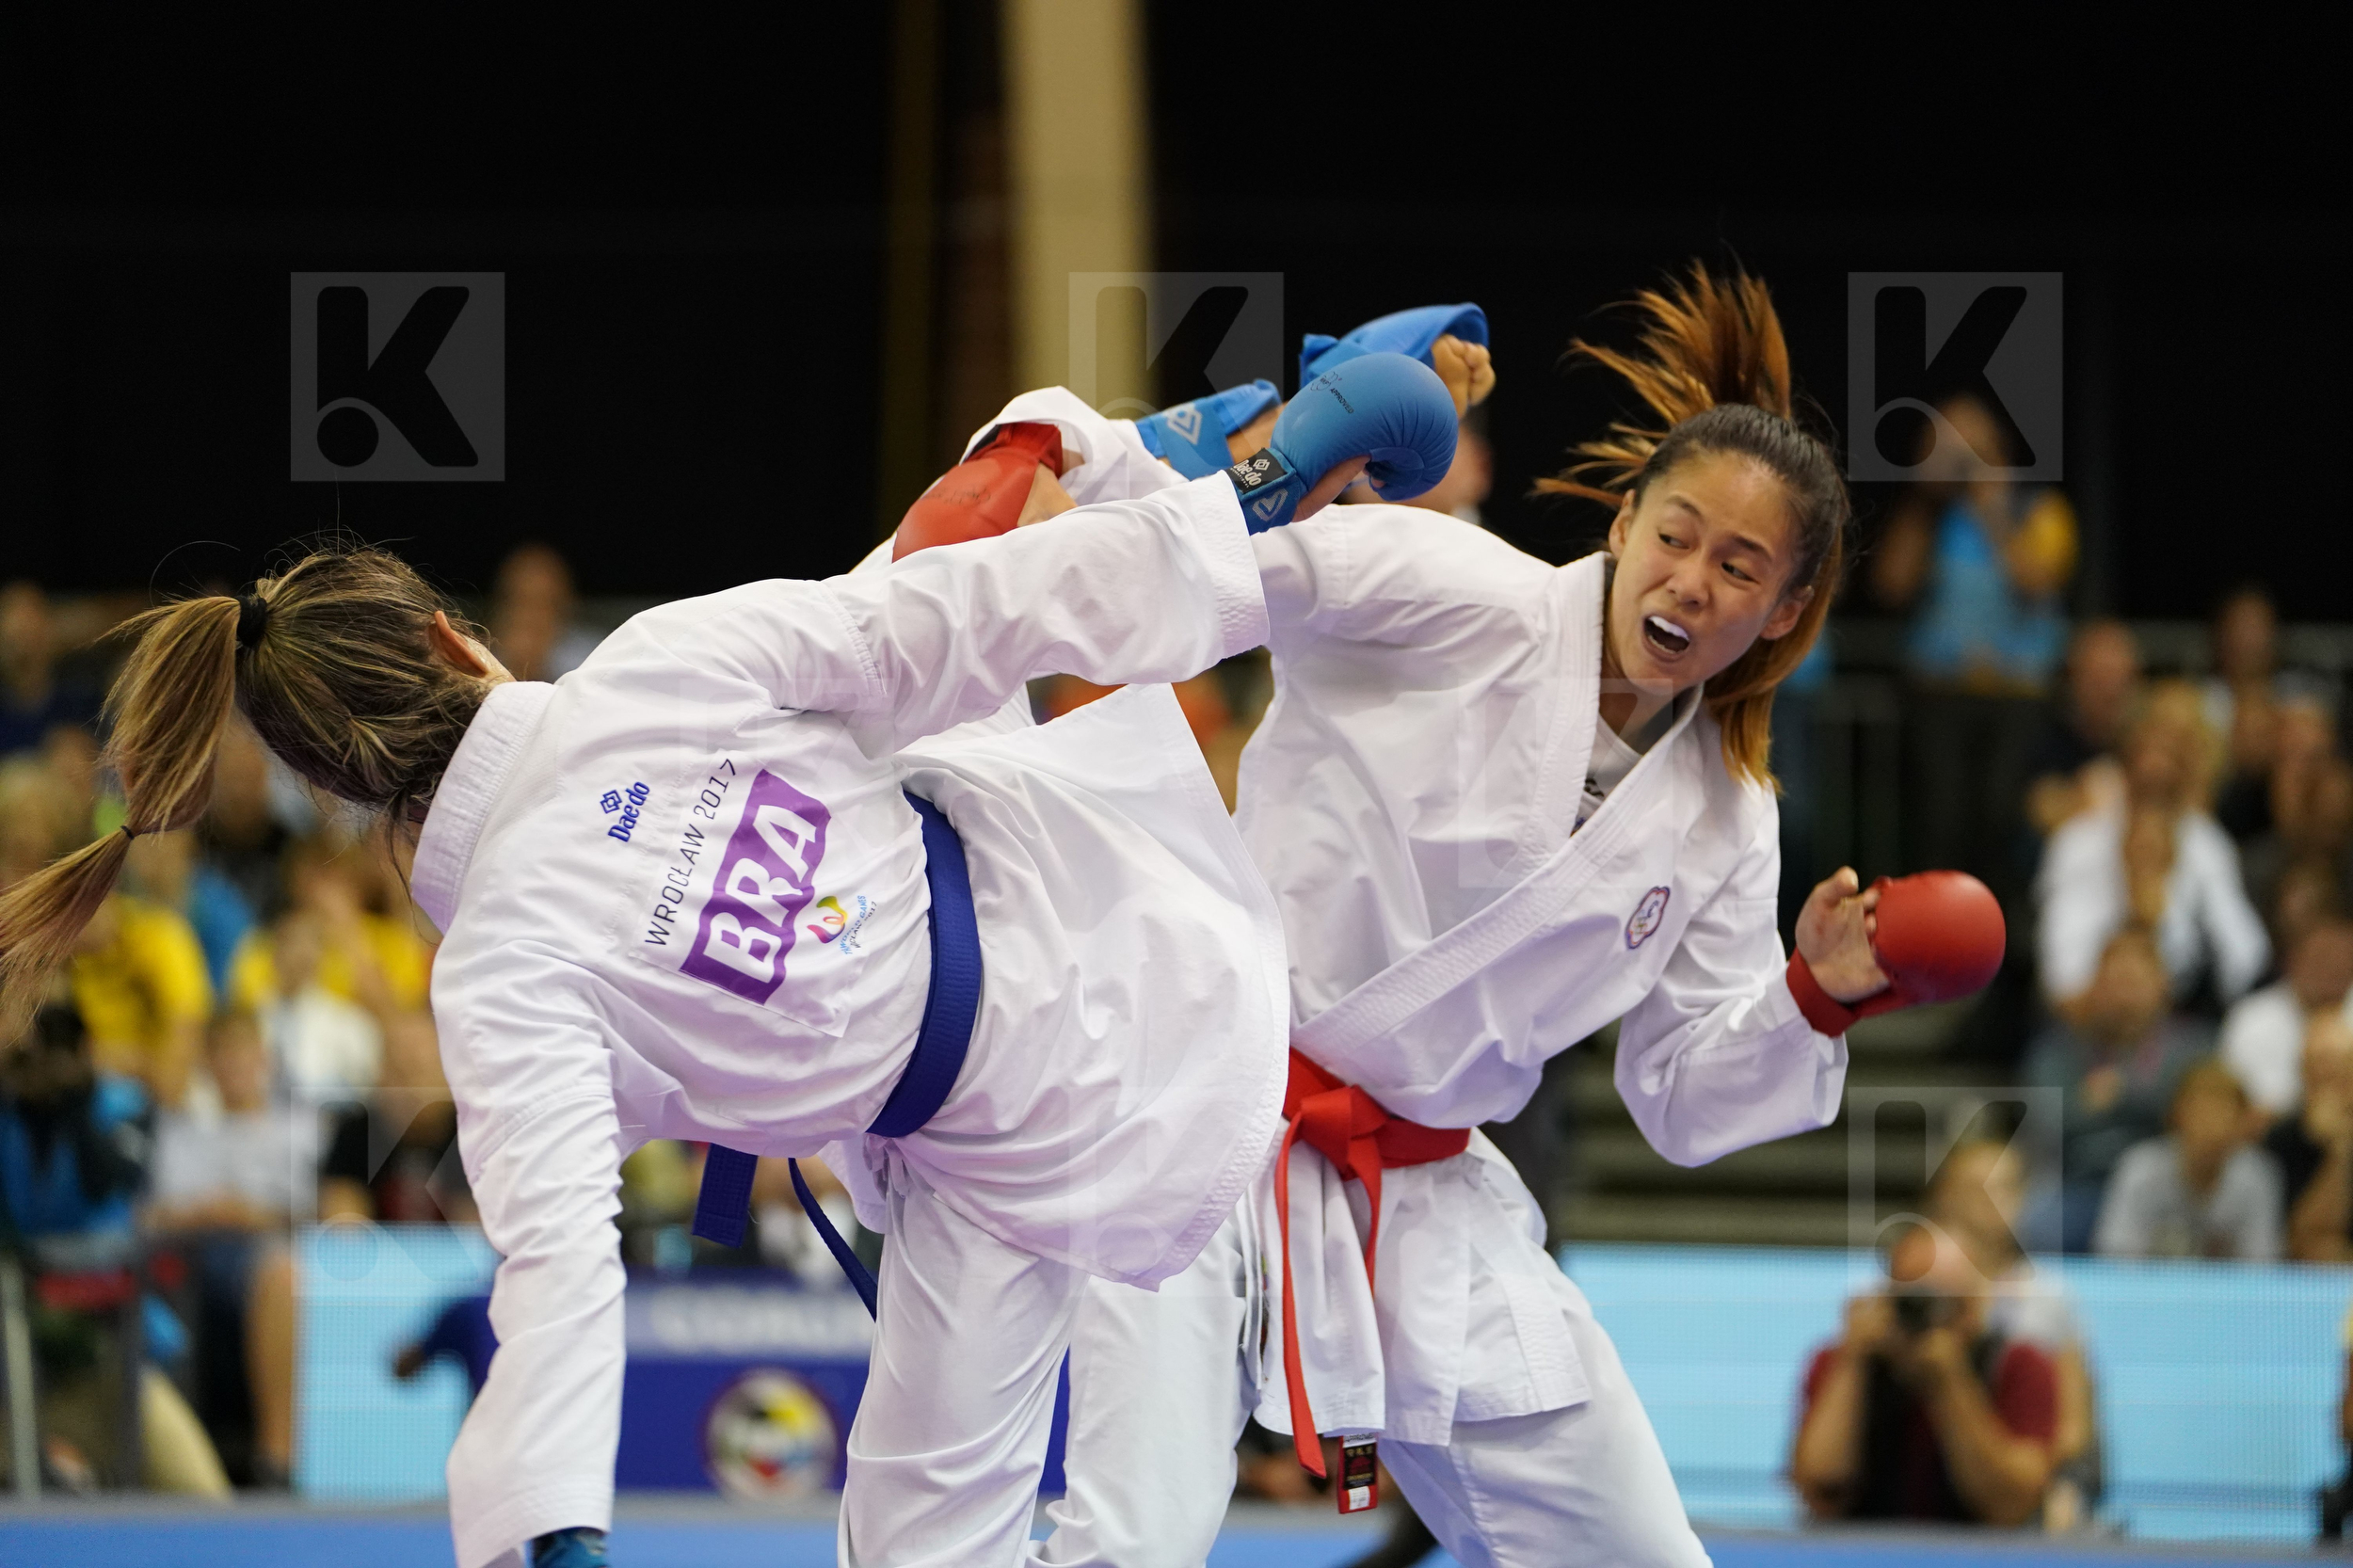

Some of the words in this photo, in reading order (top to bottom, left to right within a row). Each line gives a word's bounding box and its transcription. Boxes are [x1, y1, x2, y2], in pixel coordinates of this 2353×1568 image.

[607, 780, 650, 842] Daedo
[694, 759, 737, 820] 2017
[702, 804, 817, 984] BRA
